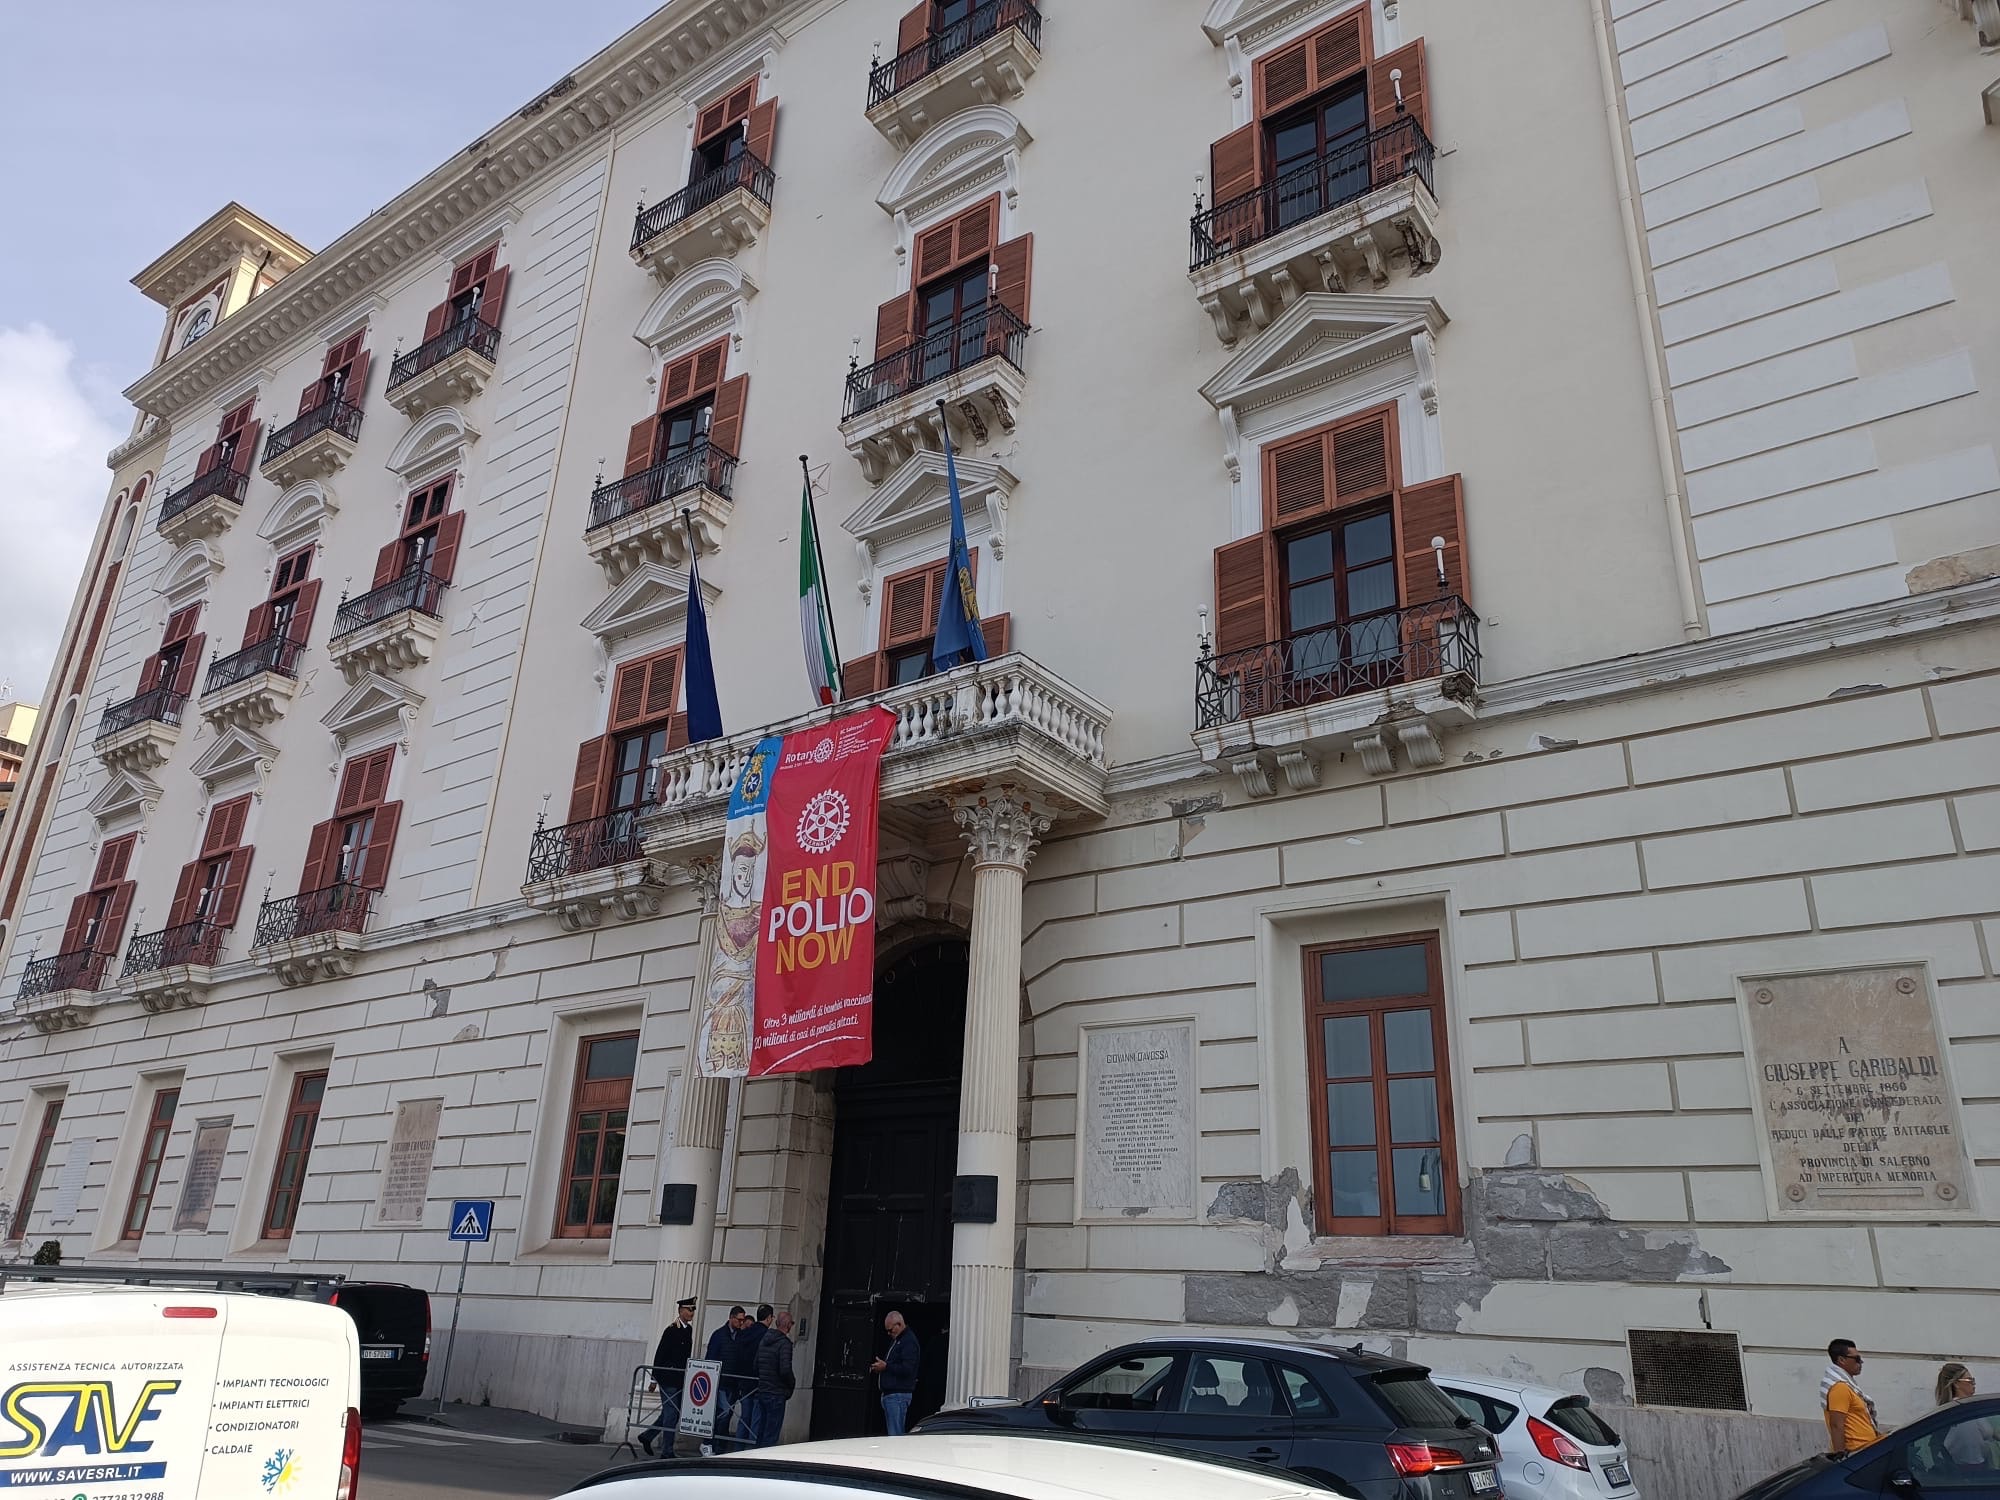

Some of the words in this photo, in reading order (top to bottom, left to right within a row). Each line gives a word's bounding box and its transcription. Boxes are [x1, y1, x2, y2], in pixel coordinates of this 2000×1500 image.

[785, 750, 814, 764] Rotary
[782, 861, 855, 905] END
[768, 888, 873, 942] POLIO
[776, 923, 855, 974] NOW
[763, 1018, 780, 1029] Oltre
[781, 1013, 787, 1026] 3
[788, 1005, 817, 1024] miliardi
[817, 1005, 823, 1017] di
[762, 1029, 789, 1047] milioni
[789, 1030, 796, 1042] di
[796, 1027, 809, 1040] casi
[809, 1025, 816, 1037] di
[815, 1019, 837, 1037] paralisi
[837, 1013, 859, 1029] evitati
[1839, 1036, 1851, 1054] A
[1764, 1060, 1841, 1082] GIUSEPPE
[1848, 1055, 1939, 1078] GARIBALDI
[1810, 1083, 1873, 1097] SETTEMBRE
[1771, 1129, 1808, 1141] REDUCI
[1812, 1127, 1845, 1139] DALLE
[1848, 1126, 1887, 1138] PATRIE
[1893, 1125, 1951, 1136] BATTAGLIE
[1843, 1142, 1880, 1152] DELLA
[1799, 1157, 1858, 1168] PROVINCIA
[1862, 1156, 1874, 1167] DI
[1879, 1155, 1931, 1167] SALERNO
[1799, 1173, 1812, 1183] AD
[1817, 1170, 1882, 1183] IMPERITURA
[1887, 1171, 1937, 1182] MEMORIA
[9, 1362, 71, 1372] ASSISTENZA
[74, 1362, 116, 1371] TECNICA
[121, 1362, 184, 1371] AUTORIZZATA
[222, 1379, 267, 1388] IMPIANTI
[269, 1378, 329, 1387] TECNOLOGICI
[219, 1400, 264, 1410] IMPIANTI
[266, 1399, 310, 1409] ELETTRICI
[0, 1379, 182, 1460] SAVE
[215, 1420, 300, 1432] CONDIZIONATORI
[211, 1444, 253, 1455] CALDAIE
[11, 1465, 142, 1484] WWW.SAVESRL.IT
